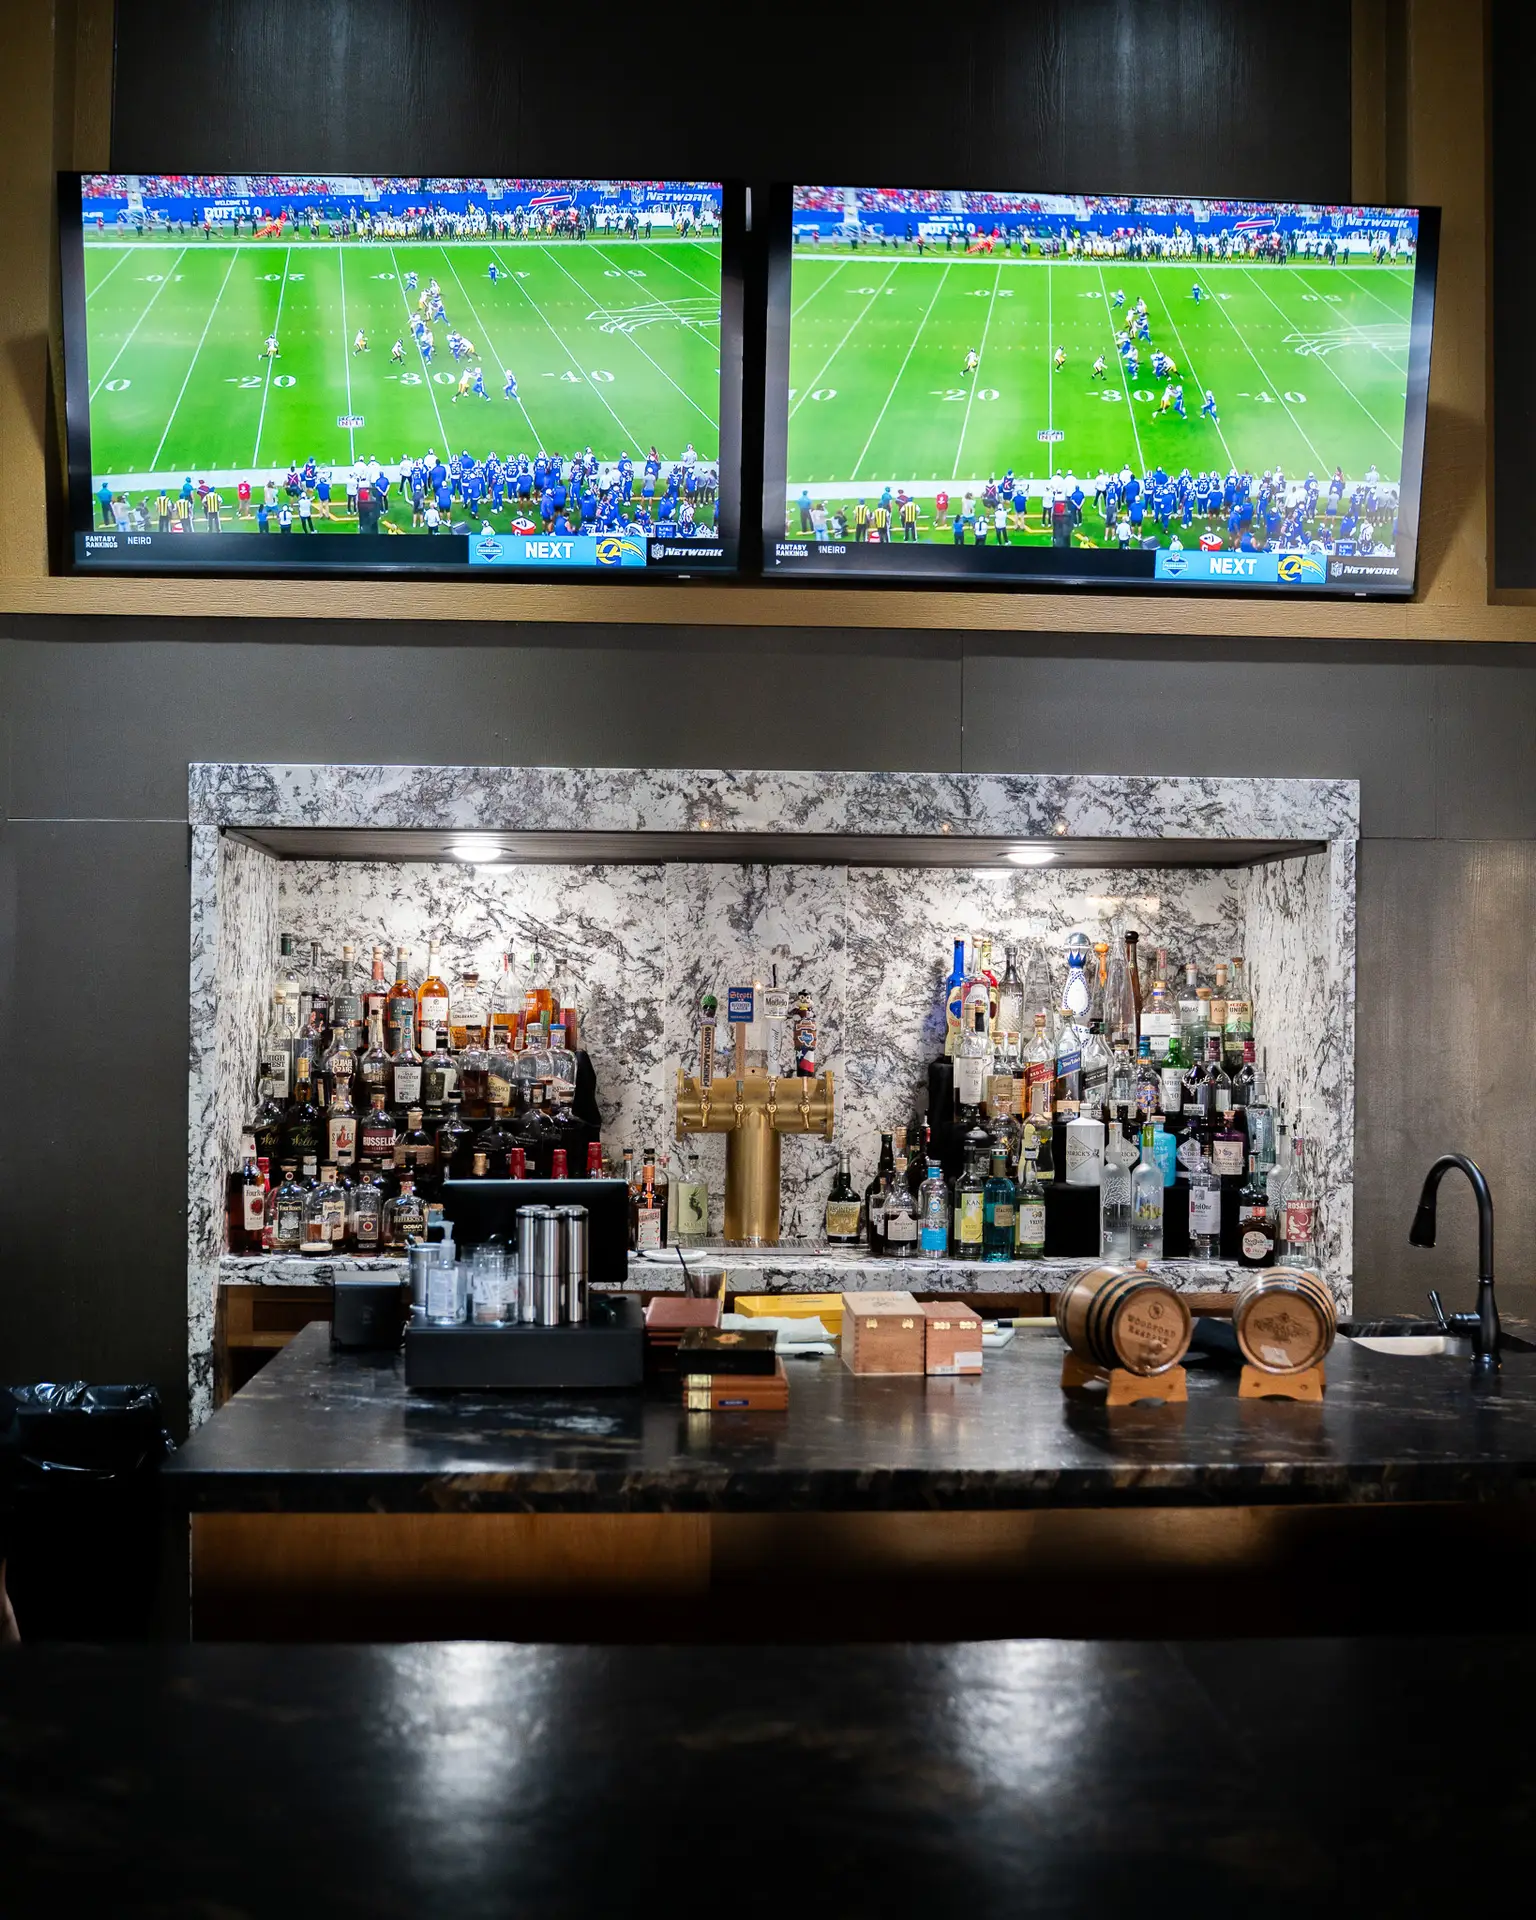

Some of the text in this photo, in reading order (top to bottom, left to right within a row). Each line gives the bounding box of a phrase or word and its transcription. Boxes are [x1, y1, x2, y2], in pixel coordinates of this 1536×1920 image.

[646, 192, 713, 202] NETWORK
[127, 536, 152, 545] NEIRO
[525, 541, 575, 559] NEXT
[665, 547, 724, 557] NETWORK
[1209, 557, 1258, 575] NEXT
[1344, 565, 1400, 576] NETWORK
[765, 997, 788, 1006] Modelo
[703, 1053, 711, 1083] MACHINE
